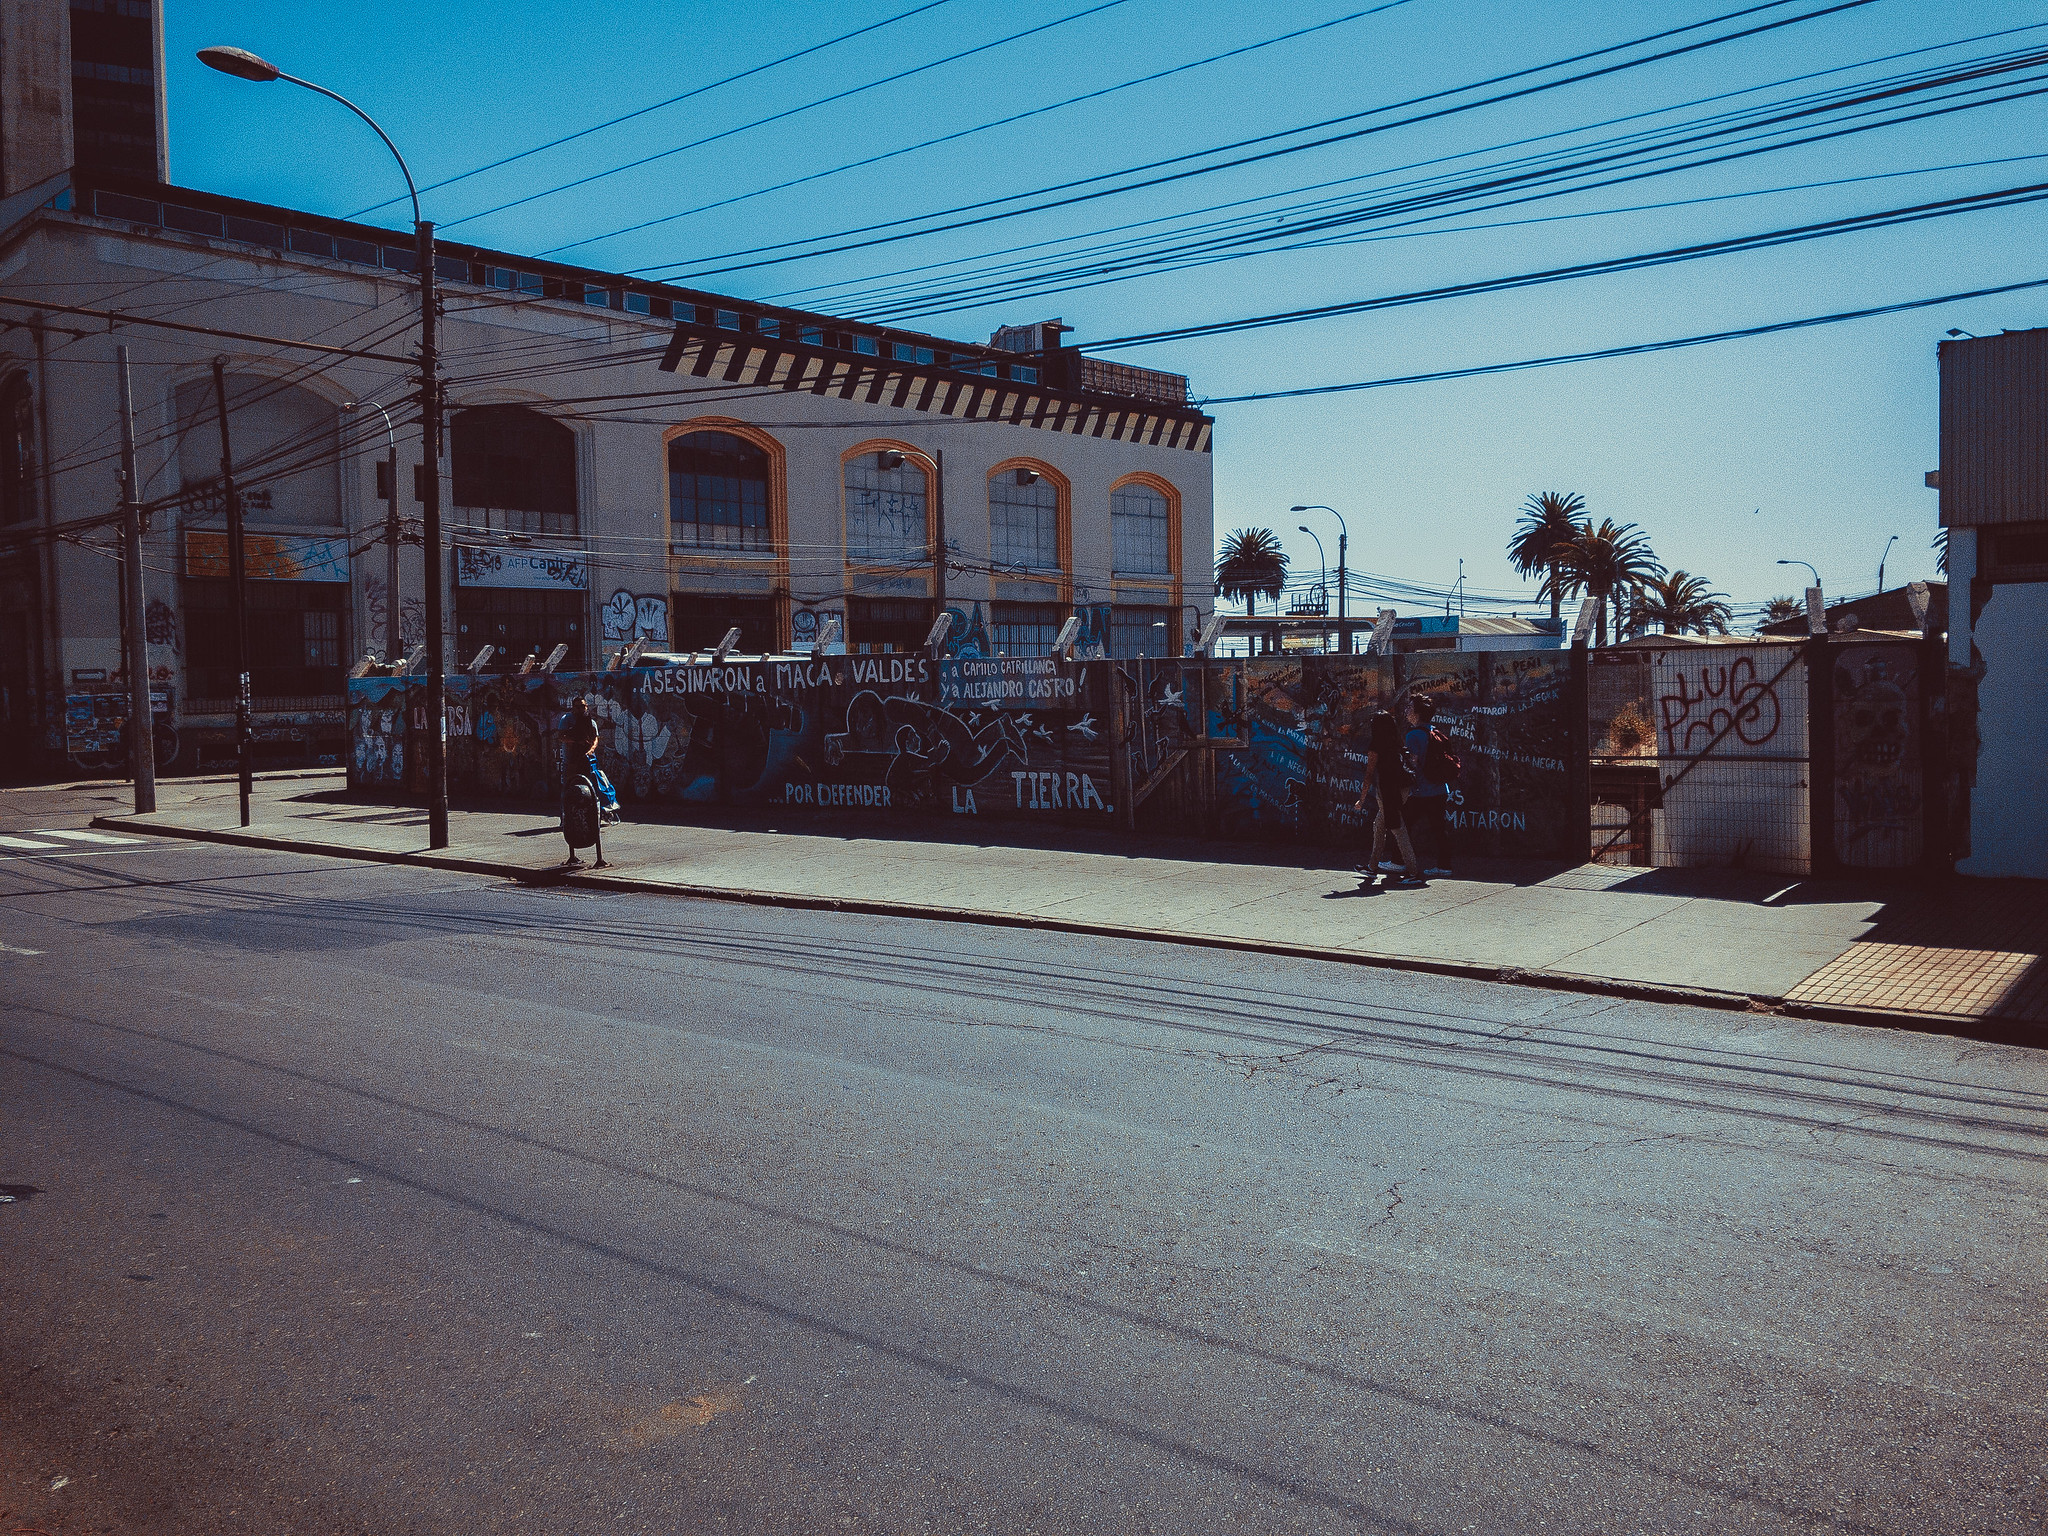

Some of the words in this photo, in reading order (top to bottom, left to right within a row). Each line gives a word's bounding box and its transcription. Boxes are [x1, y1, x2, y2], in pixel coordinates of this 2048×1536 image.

[507, 558, 528, 569] AFP
[963, 661, 998, 677] CAMILO
[1494, 664, 1510, 676] AL
[756, 674, 767, 693] a
[776, 662, 833, 690] MACA
[963, 680, 1023, 699] ALEJANDRO
[1470, 704, 1508, 717] MATARON
[1450, 726, 1475, 740] NEGRA
[1532, 757, 1566, 773] NEGRA
[817, 782, 893, 808] DEFENDER
[952, 786, 978, 815] LA
[1444, 808, 1526, 832] MATARON
